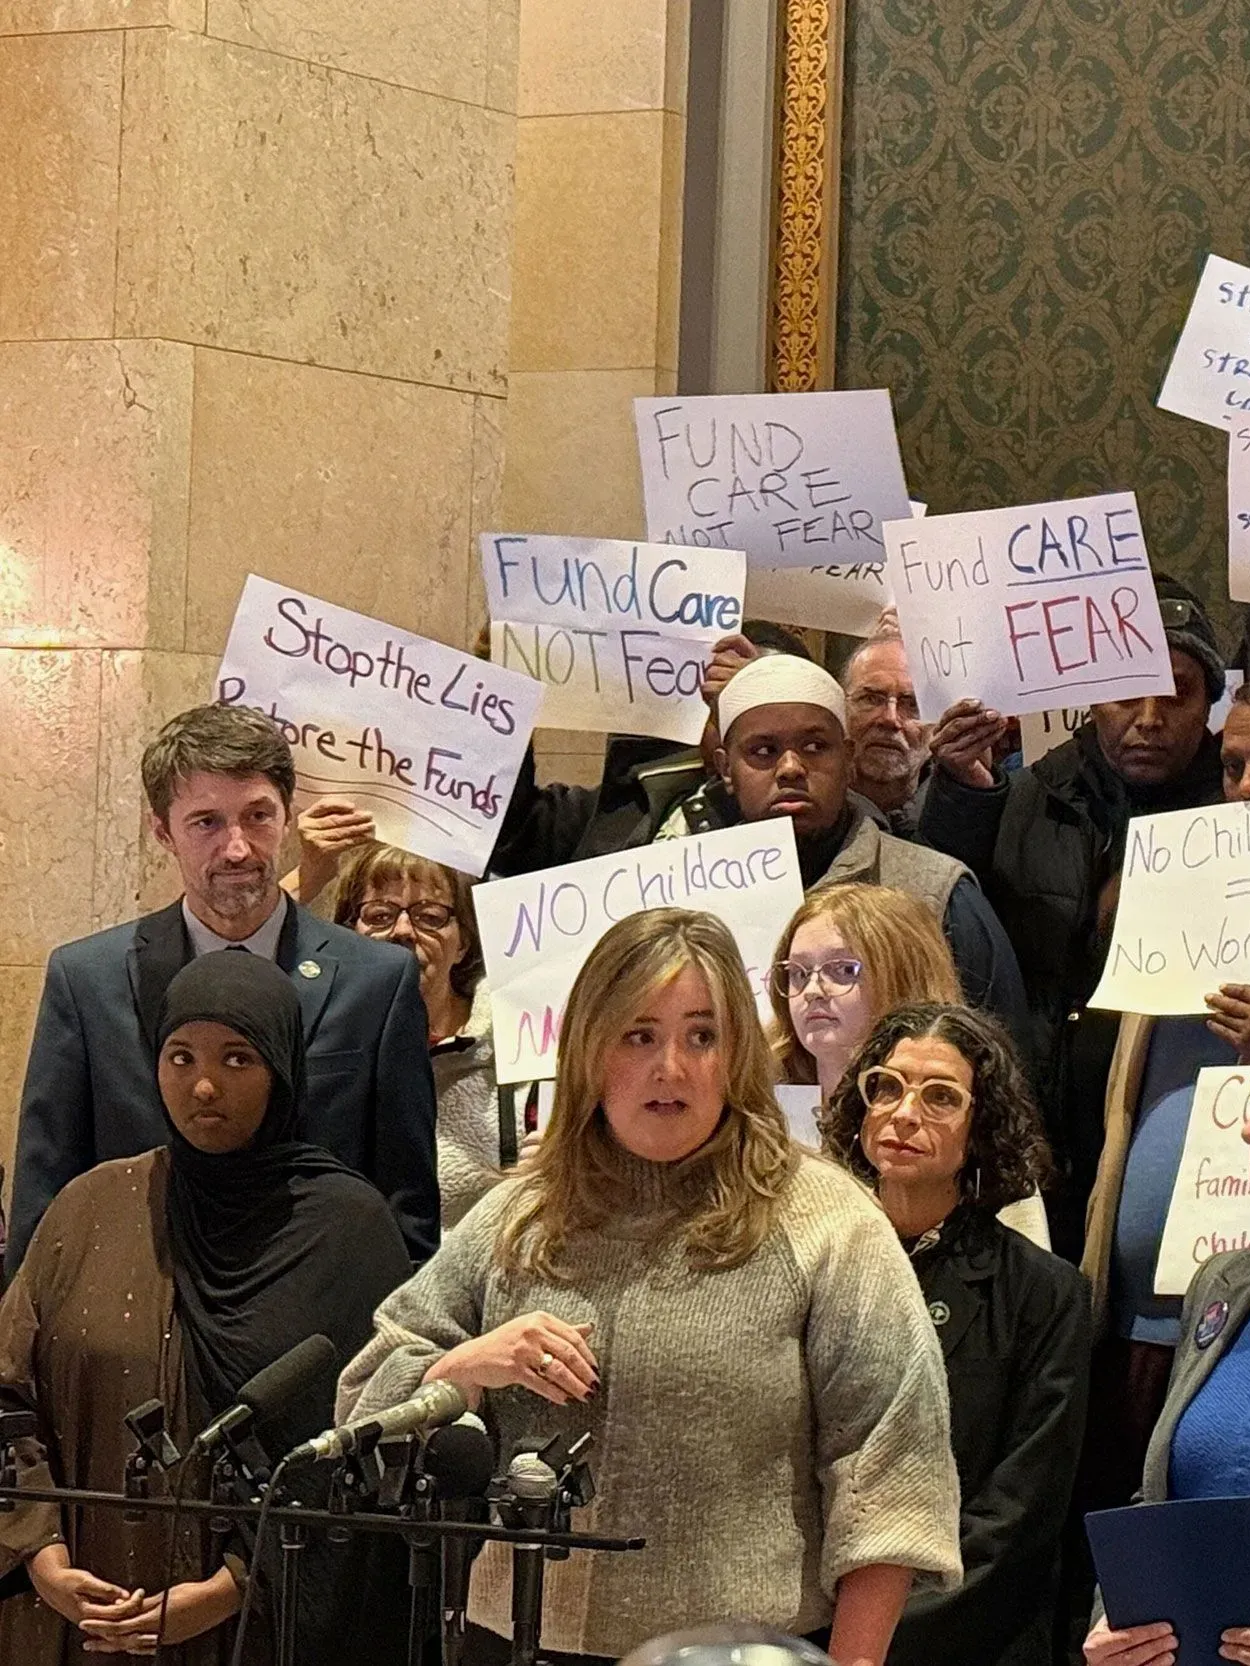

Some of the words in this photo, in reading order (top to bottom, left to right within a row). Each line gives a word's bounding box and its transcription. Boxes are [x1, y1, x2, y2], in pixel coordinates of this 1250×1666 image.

[653, 406, 804, 480] FUND
[687, 467, 853, 518] CARE
[772, 509, 885, 553] FEAR
[493, 536, 643, 619] Fund
[647, 559, 742, 629] Care
[900, 535, 991, 594] Fund
[1007, 509, 1143, 574] CARE
[263, 597, 375, 689] Stop
[376, 640, 437, 706] the
[440, 663, 516, 736] Lies
[501, 622, 609, 694] NOT
[920, 616, 974, 680] not
[1004, 586, 1154, 682] FEAR
[346, 726, 417, 786] the
[424, 746, 503, 820] Funds
[1127, 823, 1172, 878] No
[504, 882, 588, 958] NO
[602, 841, 788, 922] Childcare
[1111, 937, 1167, 977] No
